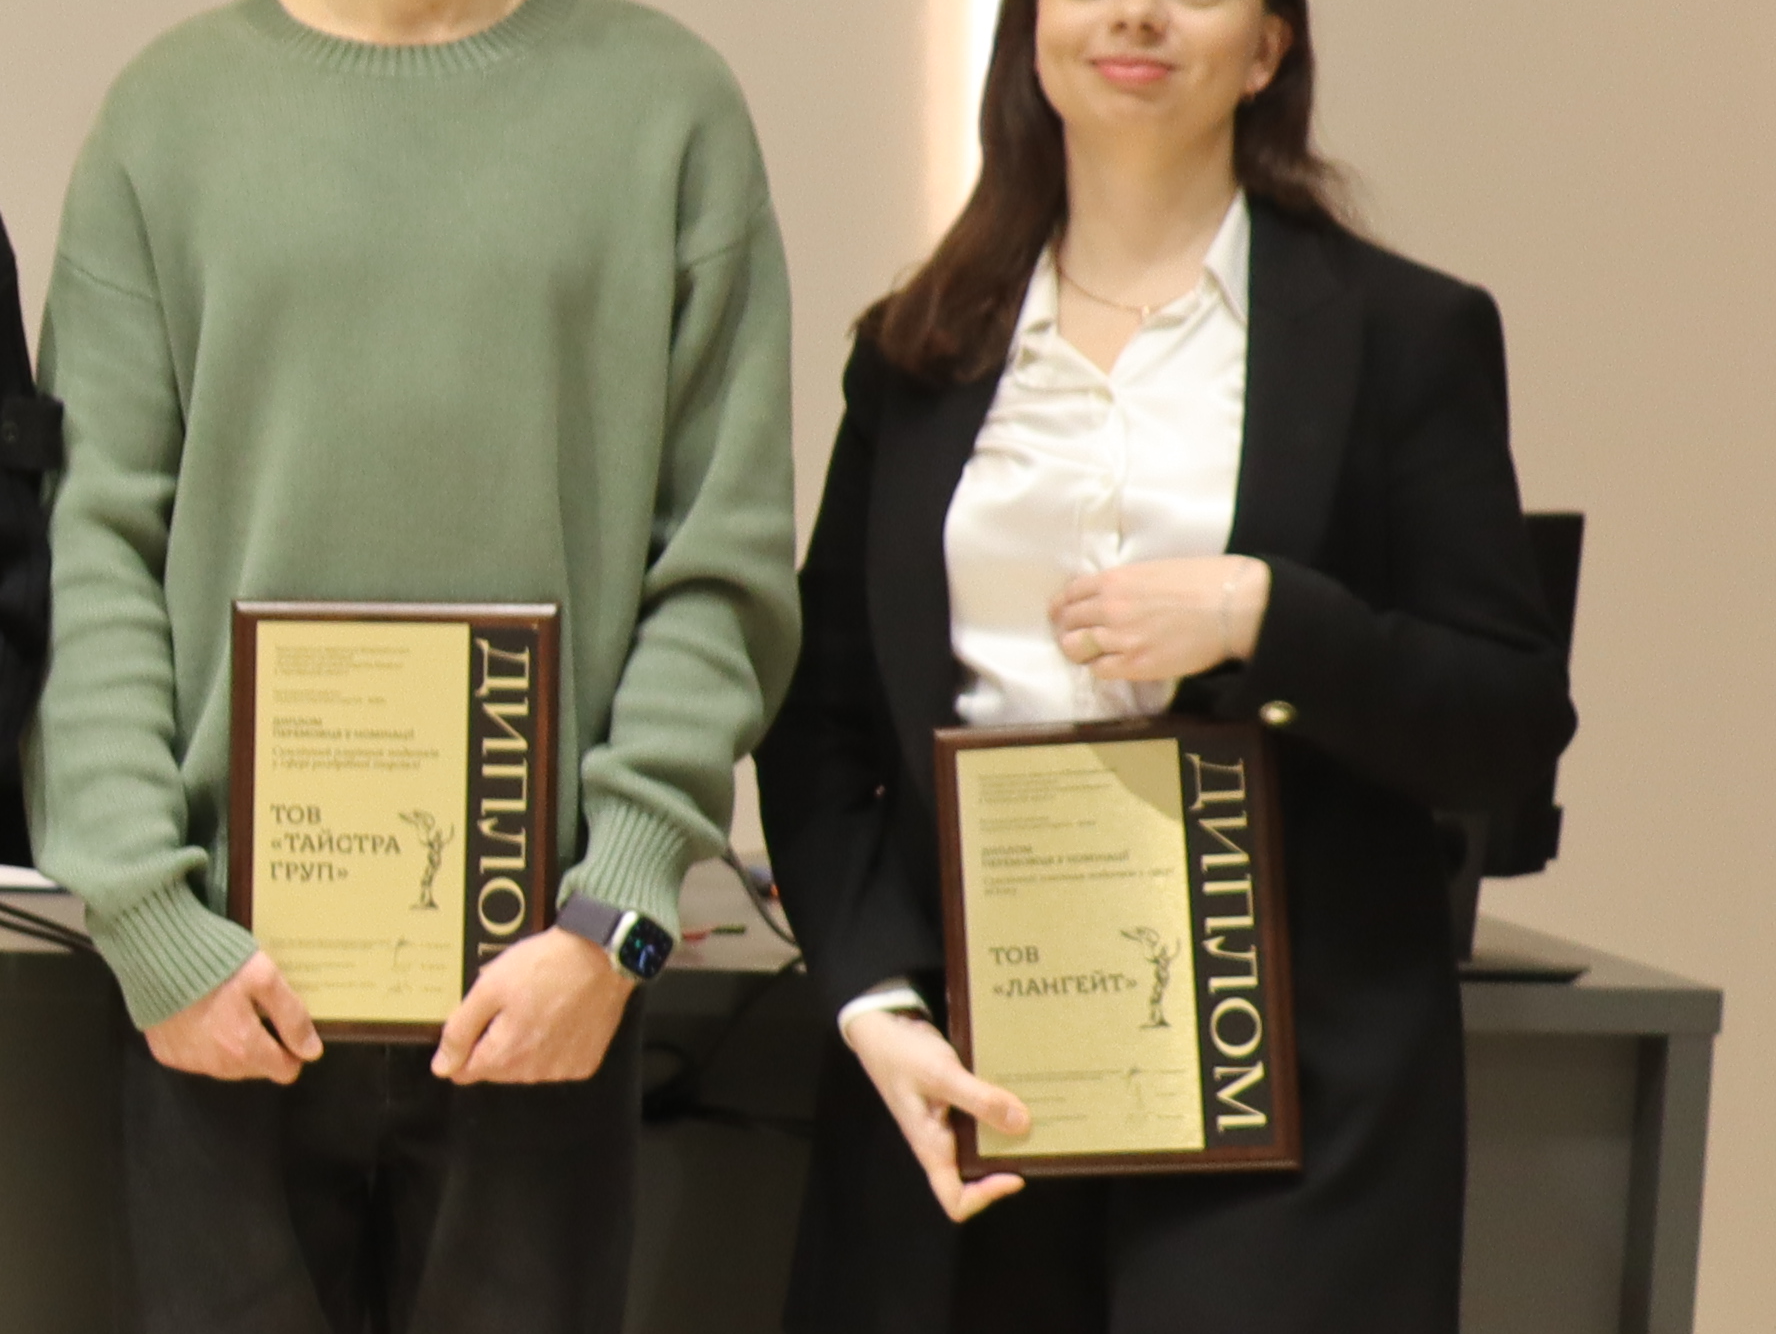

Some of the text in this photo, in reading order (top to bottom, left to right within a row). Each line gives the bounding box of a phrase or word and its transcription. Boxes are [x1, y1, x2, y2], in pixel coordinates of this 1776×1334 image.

[475, 638, 530, 959] ДИПЛО
[270, 803, 321, 825] ТОВ
[270, 827, 401, 855] «ТАЙСТРА
[270, 860, 348, 882] ГРУП»
[988, 945, 1040, 965] ТОВ
[1184, 753, 1268, 1135] ДИПЛОМ
[993, 969, 1138, 998] «ЛАНГЕЙТ»
